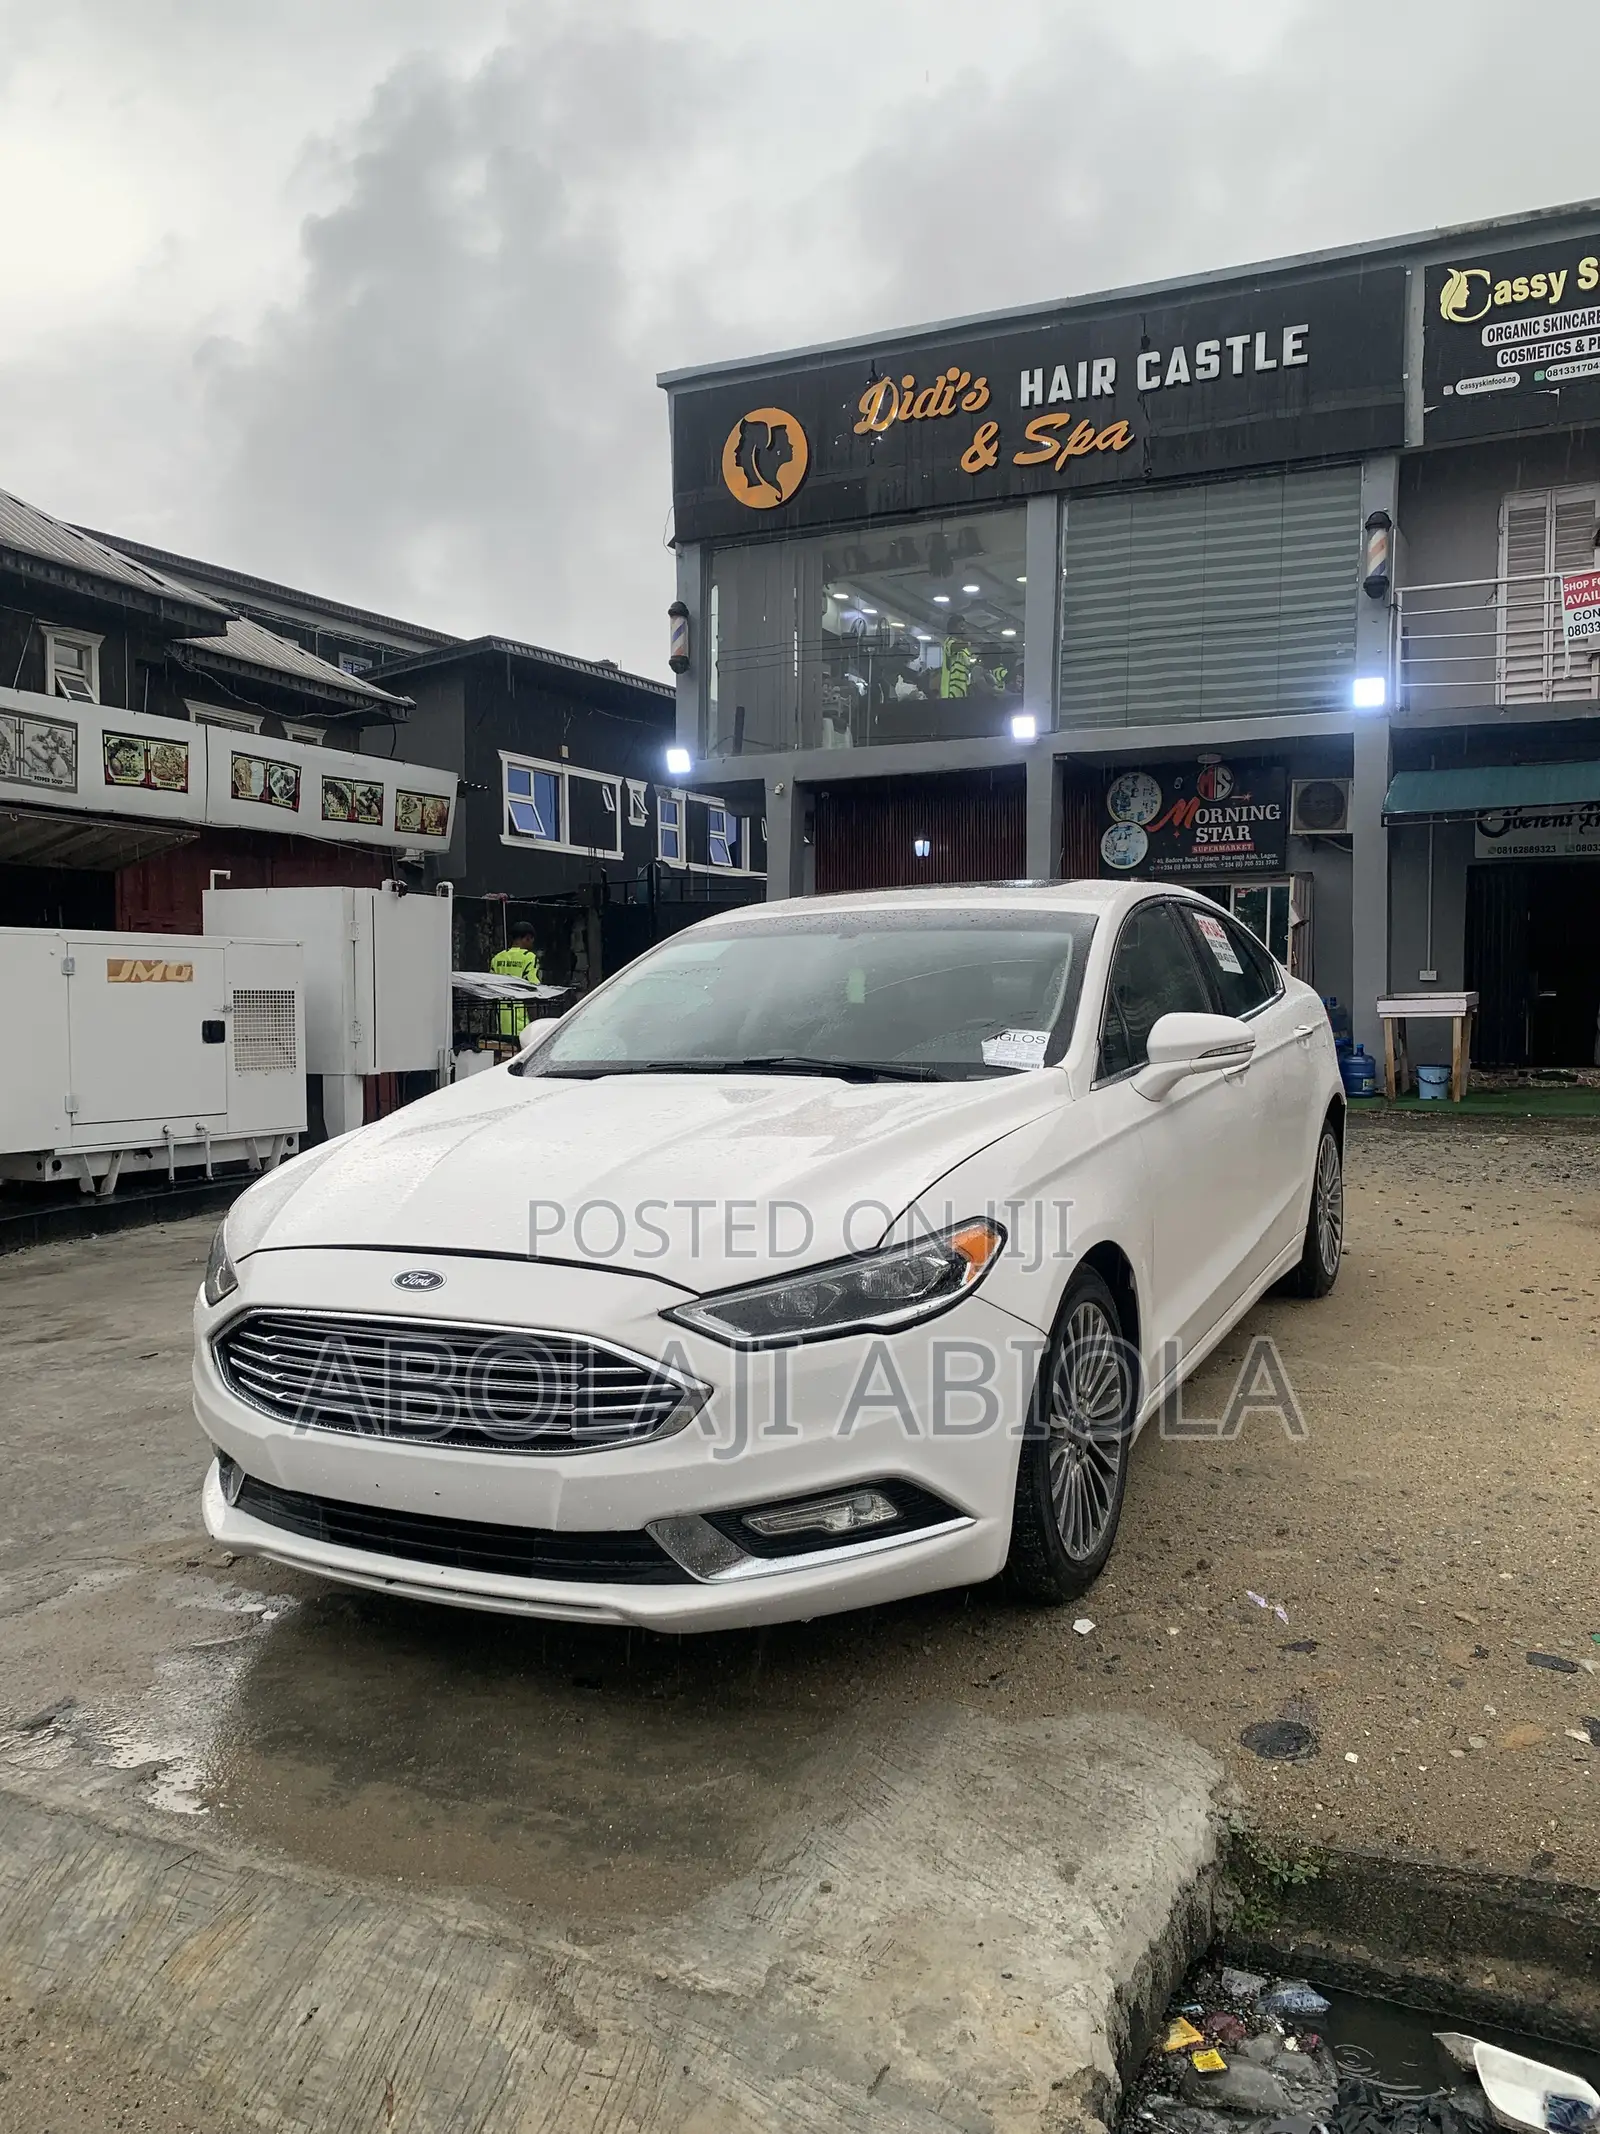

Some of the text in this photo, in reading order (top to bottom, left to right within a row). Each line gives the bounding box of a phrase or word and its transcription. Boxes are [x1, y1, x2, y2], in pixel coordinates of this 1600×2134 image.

[1440, 268, 1568, 322] Cassy
[1487, 320, 1540, 342] ORGANIC
[1501, 341, 1571, 365] COSMETICS
[1575, 339, 1585, 352] &
[853, 323, 1309, 435] Didi's HAIR CASTLE
[1547, 361, 1600, 377] 081331704
[1460, 375, 1516, 390] cassyskinfood.ng
[960, 412, 1135, 473] & Spa
[1564, 580, 1590, 592] SHOP
[1146, 797, 1282, 833] MORNING
[1195, 825, 1252, 843] STAR
[1193, 844, 1252, 853] SUPERMARKET
